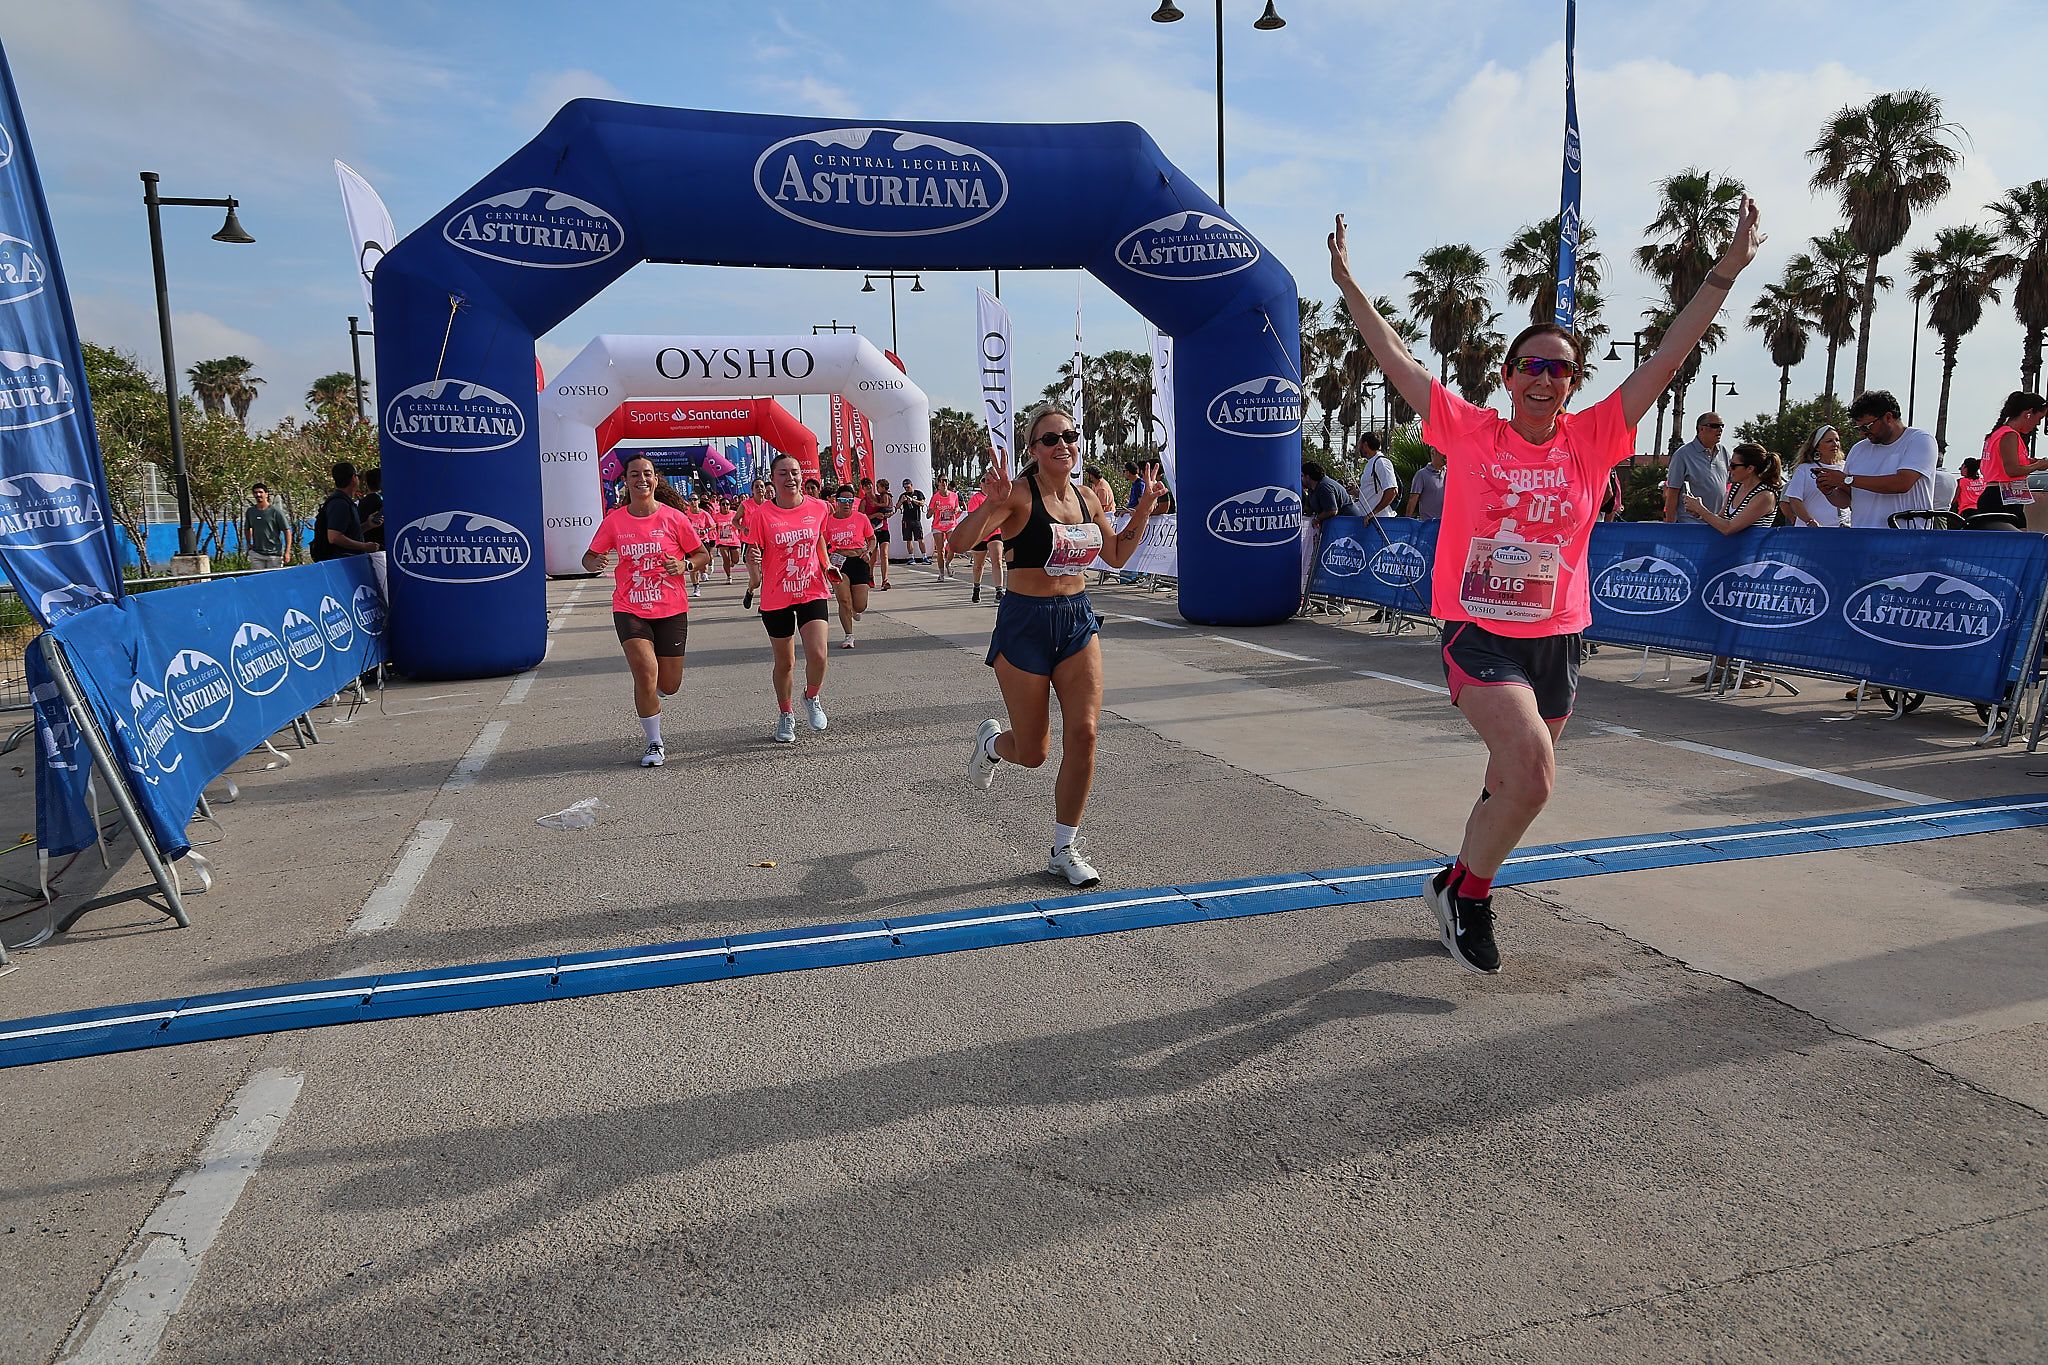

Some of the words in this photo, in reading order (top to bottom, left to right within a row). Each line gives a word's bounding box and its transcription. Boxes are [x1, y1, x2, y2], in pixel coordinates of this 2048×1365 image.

[814, 154, 894, 169] CENTRAL
[902, 159, 981, 172] LECHERA
[775, 155, 990, 208] ASTURIANA
[485, 212, 545, 223] CENTRAL
[551, 216, 608, 230] LECHERA
[455, 214, 611, 252] ASTURIANA
[1152, 234, 1201, 245] CENTRAL
[1128, 240, 1254, 265] ASTURIANA
[655, 347, 815, 379] OYSHO
[558, 385, 609, 396] OYSHO
[858, 380, 904, 391] OYSHO
[409, 403, 460, 411] CENTRAL
[464, 405, 513, 415] LECHERA
[1236, 397, 1275, 405] CENTRAL
[630, 410, 670, 424] Sports
[688, 408, 750, 421] Santander
[1216, 400, 1301, 424] ASTURIAN
[392, 406, 518, 436] ASTURIANA
[541, 450, 588, 462] OYSHO
[885, 443, 926, 454] OYSHO
[1235, 506, 1275, 514] CENTRAL
[1527, 494, 1559, 523] DE
[546, 516, 593, 528] OYSHO
[1215, 509, 1301, 532] ASTURIAN
[417, 535, 466, 543] CENTRAL
[471, 535, 519, 543] LECHERA
[775, 528, 815, 545] CARRERA
[832, 531, 854, 541] CARRERA
[1138, 524, 1177, 547] OYSH
[400, 537, 524, 564] ASTURIANA
[620, 542, 663, 556] CARRERA
[797, 542, 811, 558] DE
[1067, 549, 1087, 558] 016
[1495, 551, 1528, 561] ASTURIANA
[643, 557, 656, 571] DE
[1374, 556, 1420, 578] ASTURIANA
[643, 579, 653, 590] LA
[782, 579, 810, 593] MUJER
[1489, 576, 1525, 592] 016
[1649, 574, 1682, 585] LECHERA
[1731, 580, 1770, 592] CENTRAL
[1773, 582, 1816, 595] LECHERA
[629, 588, 662, 603] MUJER
[1598, 575, 1681, 602] ASTURIANA
[1468, 595, 1488, 603] CARRERA
[1709, 581, 1816, 616] ASTURIANA
[1881, 594, 1932, 606] CENTRAL
[1935, 600, 1990, 613] LECHERA
[1467, 605, 1496, 615] OYSHO
[1852, 594, 1989, 637] ASTURIANA
[236, 649, 287, 686] ASTURIANA
[171, 677, 230, 722] ASTURIANA
